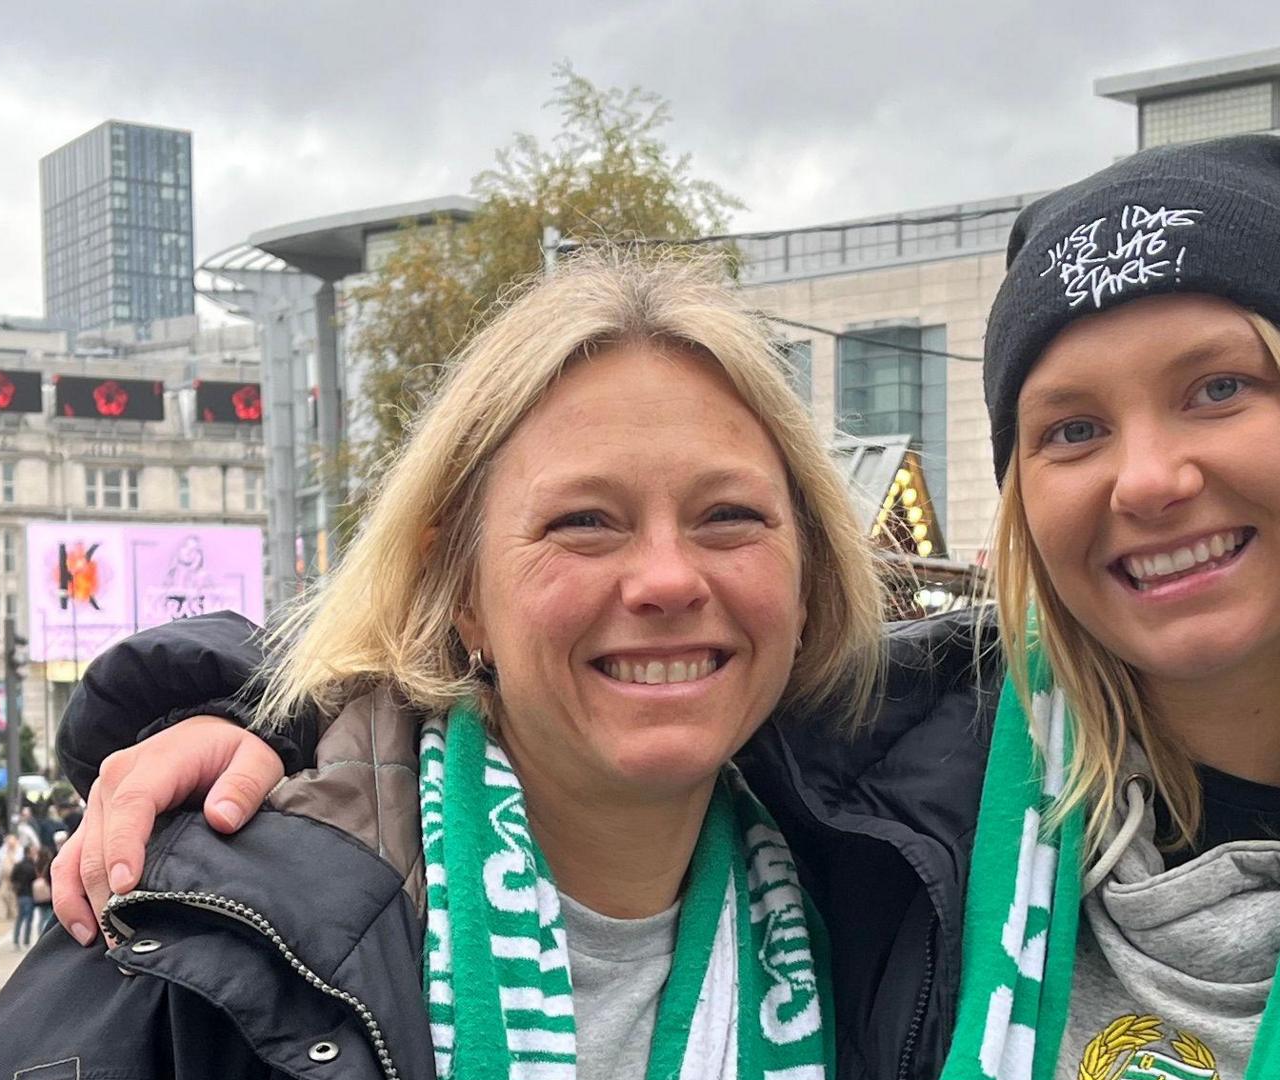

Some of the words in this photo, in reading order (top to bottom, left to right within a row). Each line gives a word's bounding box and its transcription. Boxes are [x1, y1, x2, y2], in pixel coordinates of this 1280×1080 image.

[1039, 217, 1107, 277] JUST
[1121, 205, 1204, 230] IDAG
[1056, 242, 1108, 285] ÄR
[1107, 228, 1168, 264] JAG
[1064, 246, 1187, 309] STARK!
